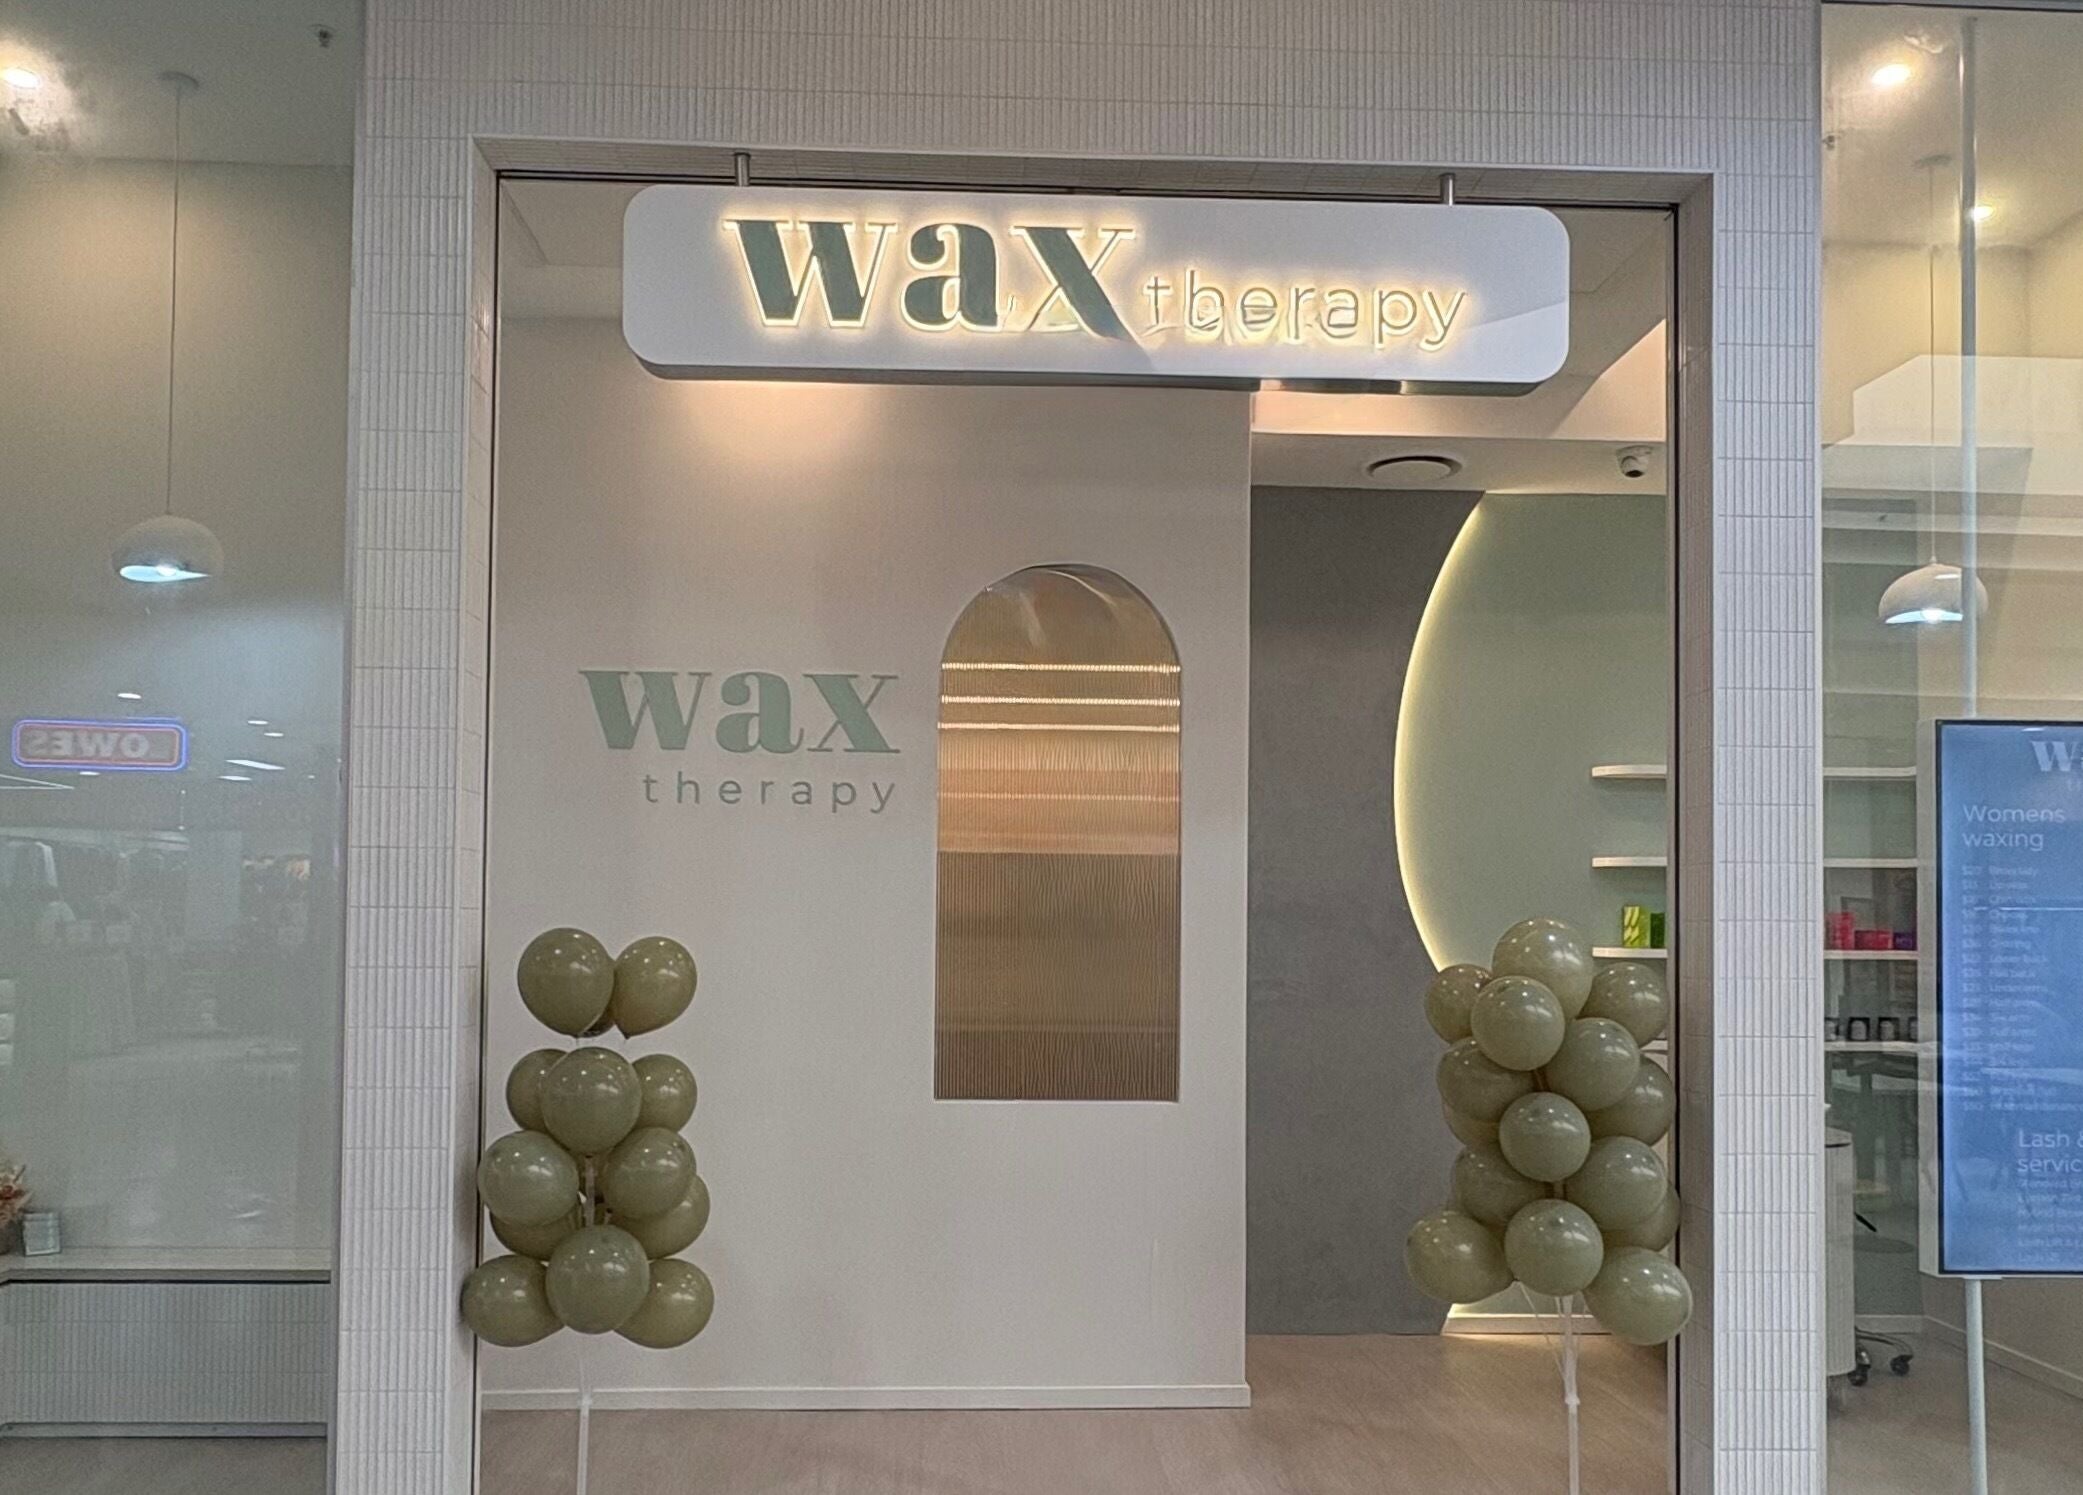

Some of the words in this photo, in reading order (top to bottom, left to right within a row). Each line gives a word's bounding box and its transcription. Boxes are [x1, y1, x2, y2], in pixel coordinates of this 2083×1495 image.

[721, 218, 1137, 340] wax
[1143, 268, 1468, 352] therapy
[578, 669, 901, 754] wax
[643, 770, 895, 813] therapy
[1962, 804, 2067, 824] Womens
[1961, 831, 2045, 852] waxing
[2018, 1127, 2070, 1148] Lash
